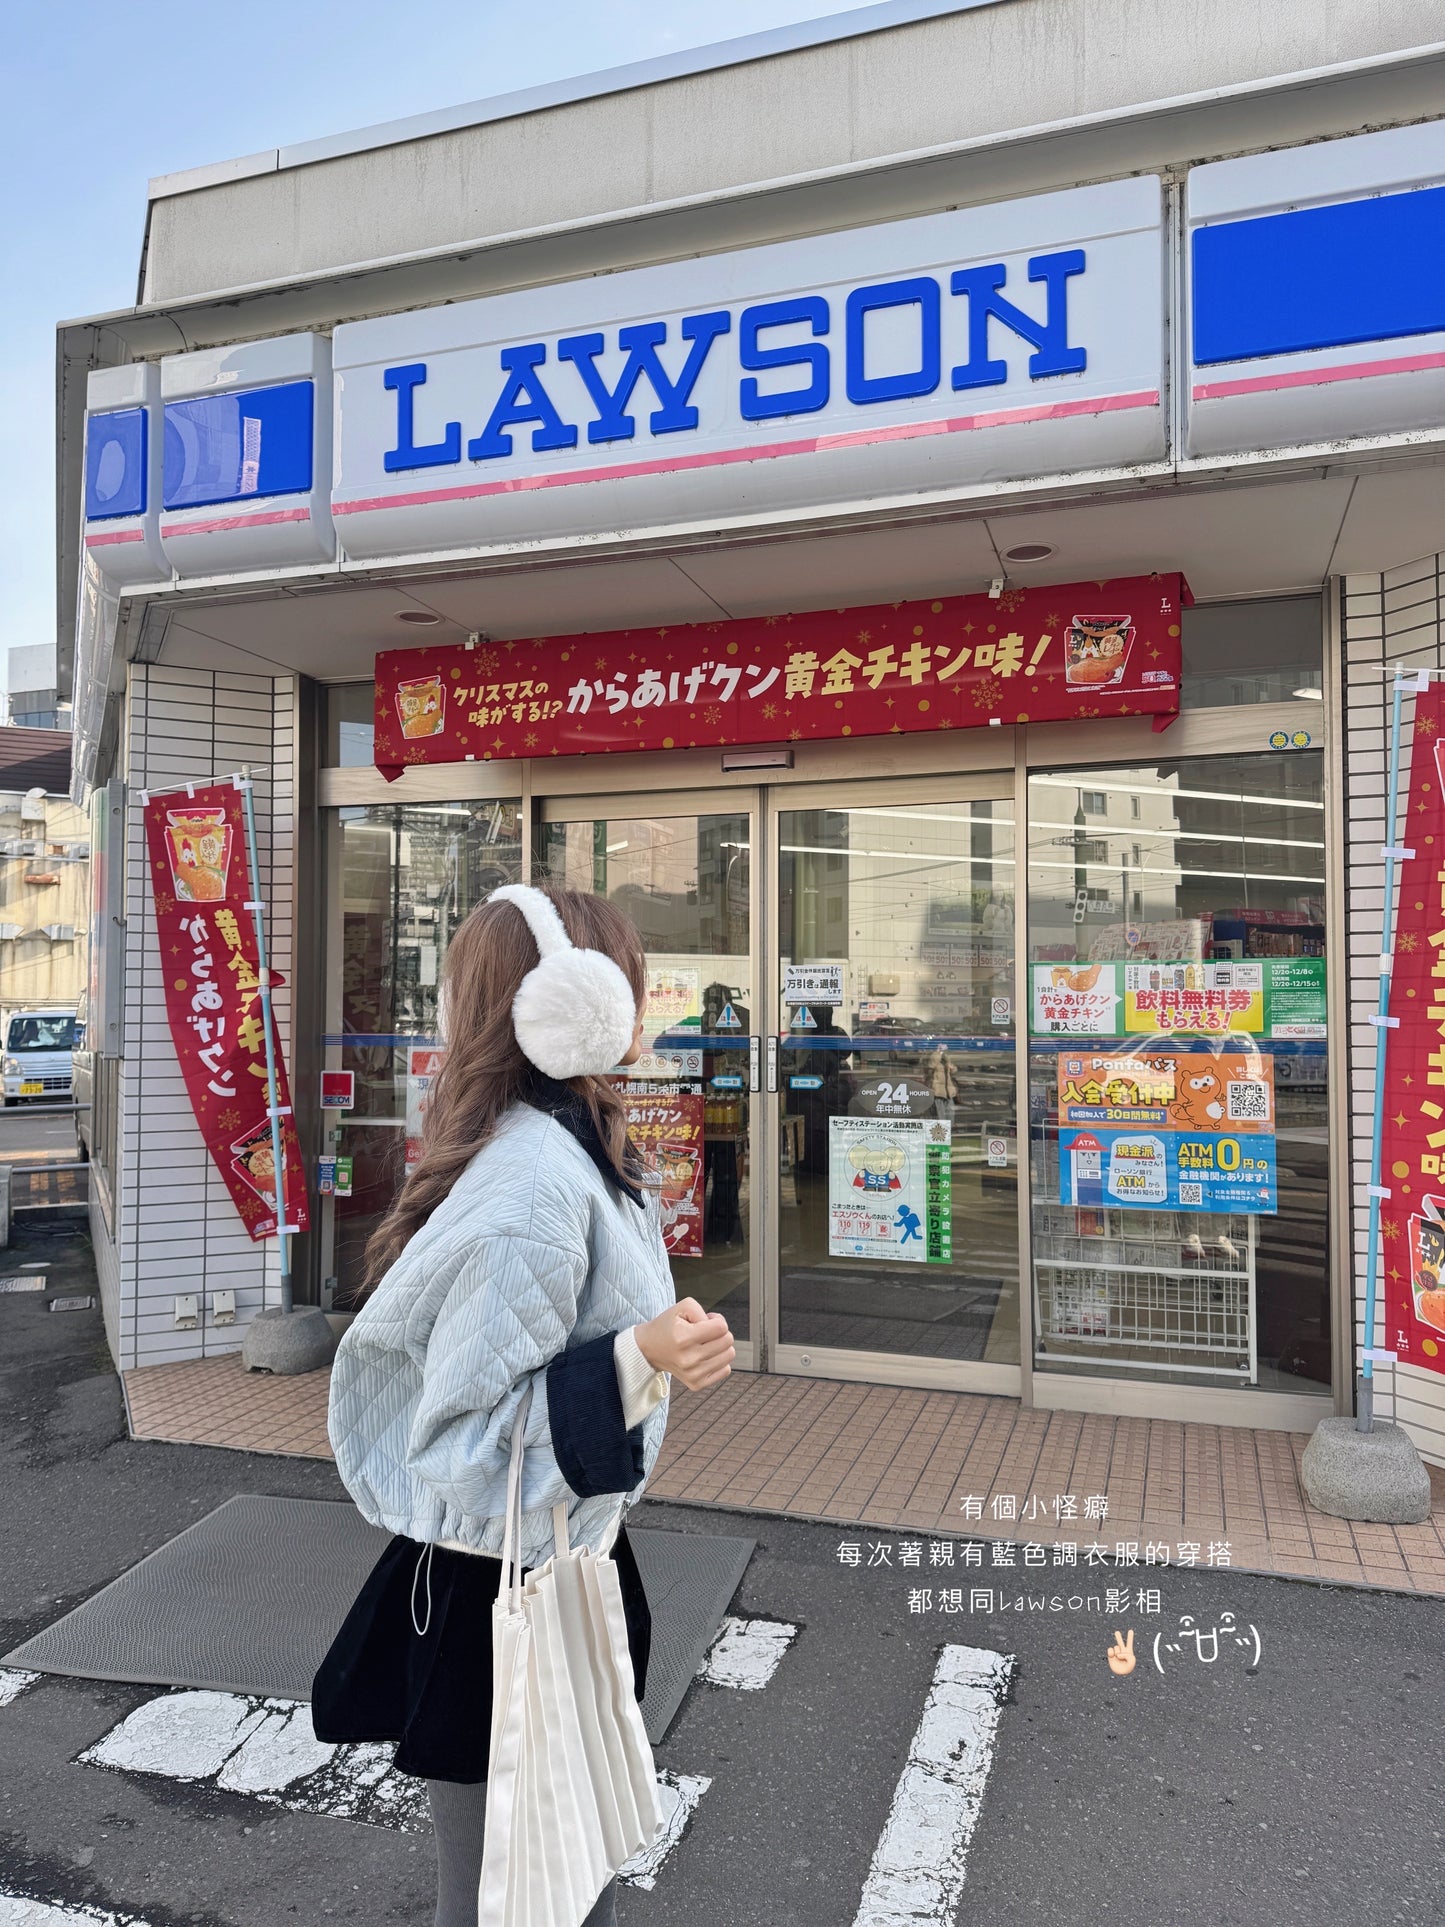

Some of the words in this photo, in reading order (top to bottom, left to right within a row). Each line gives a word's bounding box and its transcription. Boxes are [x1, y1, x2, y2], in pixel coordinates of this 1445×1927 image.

[385, 249, 1087, 472] LAWSON
[784, 632, 1053, 701] 黄金チキン味!
[453, 679, 549, 707] クリスマスの
[566, 660, 782, 716] からあげクン
[467, 701, 564, 729] 味がする!?
[1039, 993, 1111, 1006] からあげクン
[1135, 989, 1253, 1011] 飲料無料券
[1043, 1006, 1105, 1020] 黄金チキン
[1050, 1021, 1099, 1032] 購入ごとに
[1156, 1011, 1233, 1030] もらえる!
[1091, 1057, 1177, 1072] Pontaパス
[609, 1081, 702, 1095] 札幌南5条市通
[877, 1082, 910, 1104] 24
[1060, 1078, 1177, 1106] 入会受付中
[323, 1095, 350, 1104] SECOM
[624, 1107, 682, 1123] あげクン
[875, 1104, 912, 1114] 年中無休
[832, 1119, 924, 1129] セーフティステーション活動実施店
[857, 1135, 875, 1144] SAFETY
[1077, 1139, 1097, 1147] ATM
[1116, 1144, 1163, 1159] 現金派の
[1177, 1142, 1214, 1157] ATM
[1215, 1137, 1269, 1171] 0円の
[1135, 1160, 1164, 1168] みなさん!
[1177, 1157, 1214, 1169] 手数料
[1114, 1168, 1152, 1176] ローソン銀行
[1178, 1170, 1269, 1184] 金融機関があります!
[868, 1175, 886, 1185] SS
[1117, 1175, 1160, 1188] ATMから
[1116, 1188, 1164, 1197] お得なお知らせ!
[831, 1211, 895, 1221] エスゾウくんのお店へ!
[839, 1220, 851, 1228] 110
[858, 1221, 871, 1229] 119
